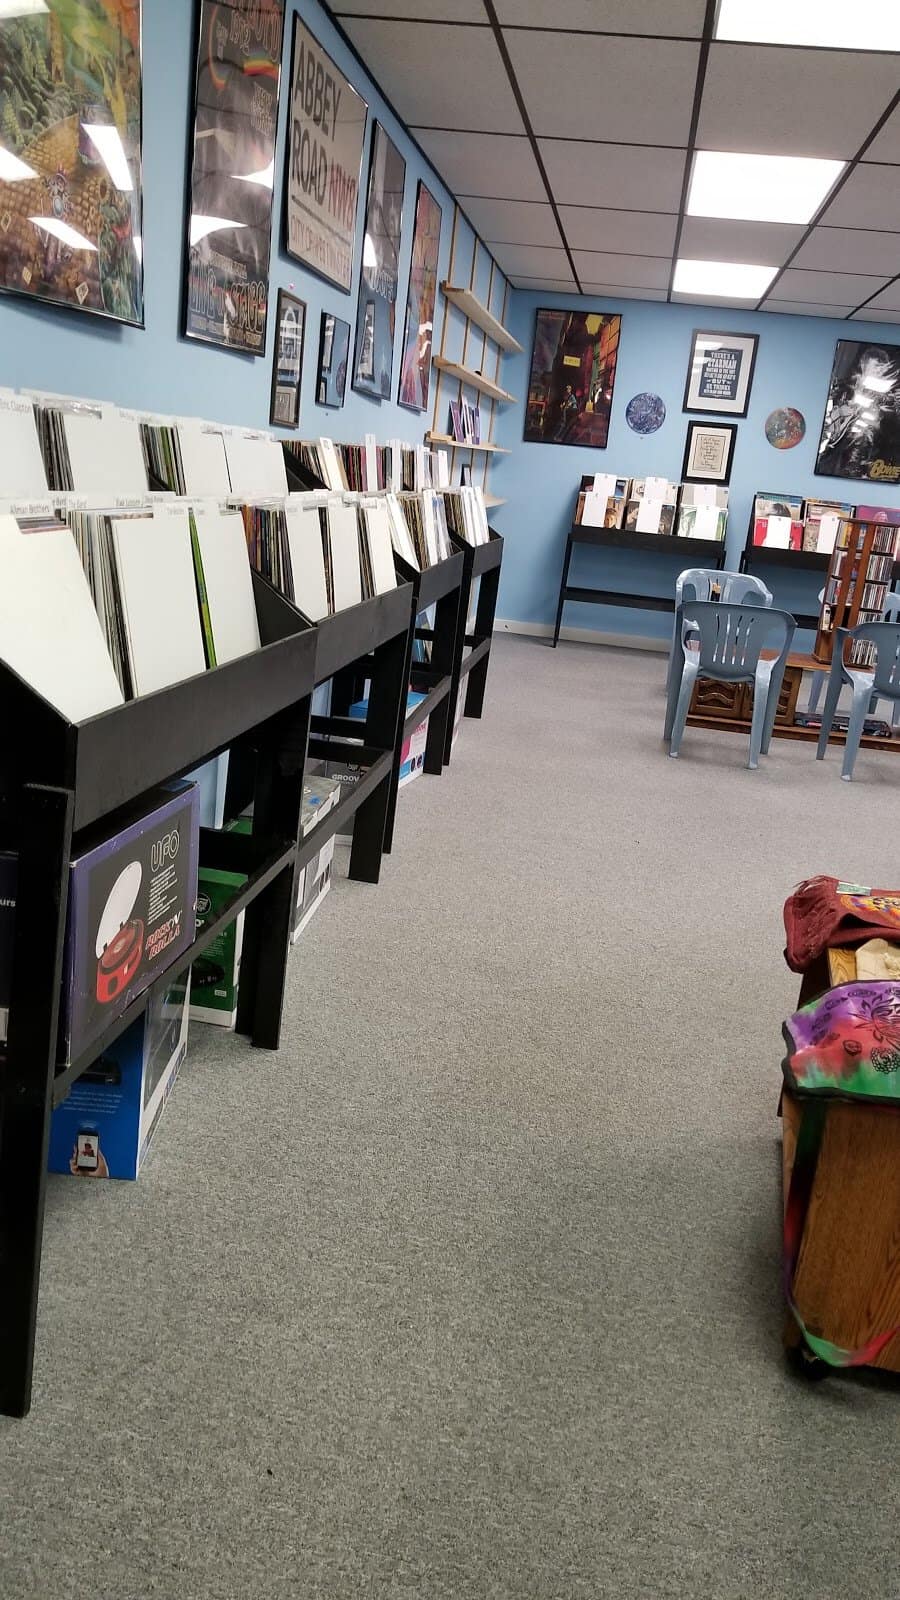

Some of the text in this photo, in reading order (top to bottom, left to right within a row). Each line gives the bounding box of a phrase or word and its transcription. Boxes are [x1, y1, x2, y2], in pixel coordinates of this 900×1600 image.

[294, 40, 342, 142] ABBEY
[292, 119, 356, 232] ROAD NW8
[331, 774, 360, 782] GROOV
[151, 829, 180, 873] UFO
